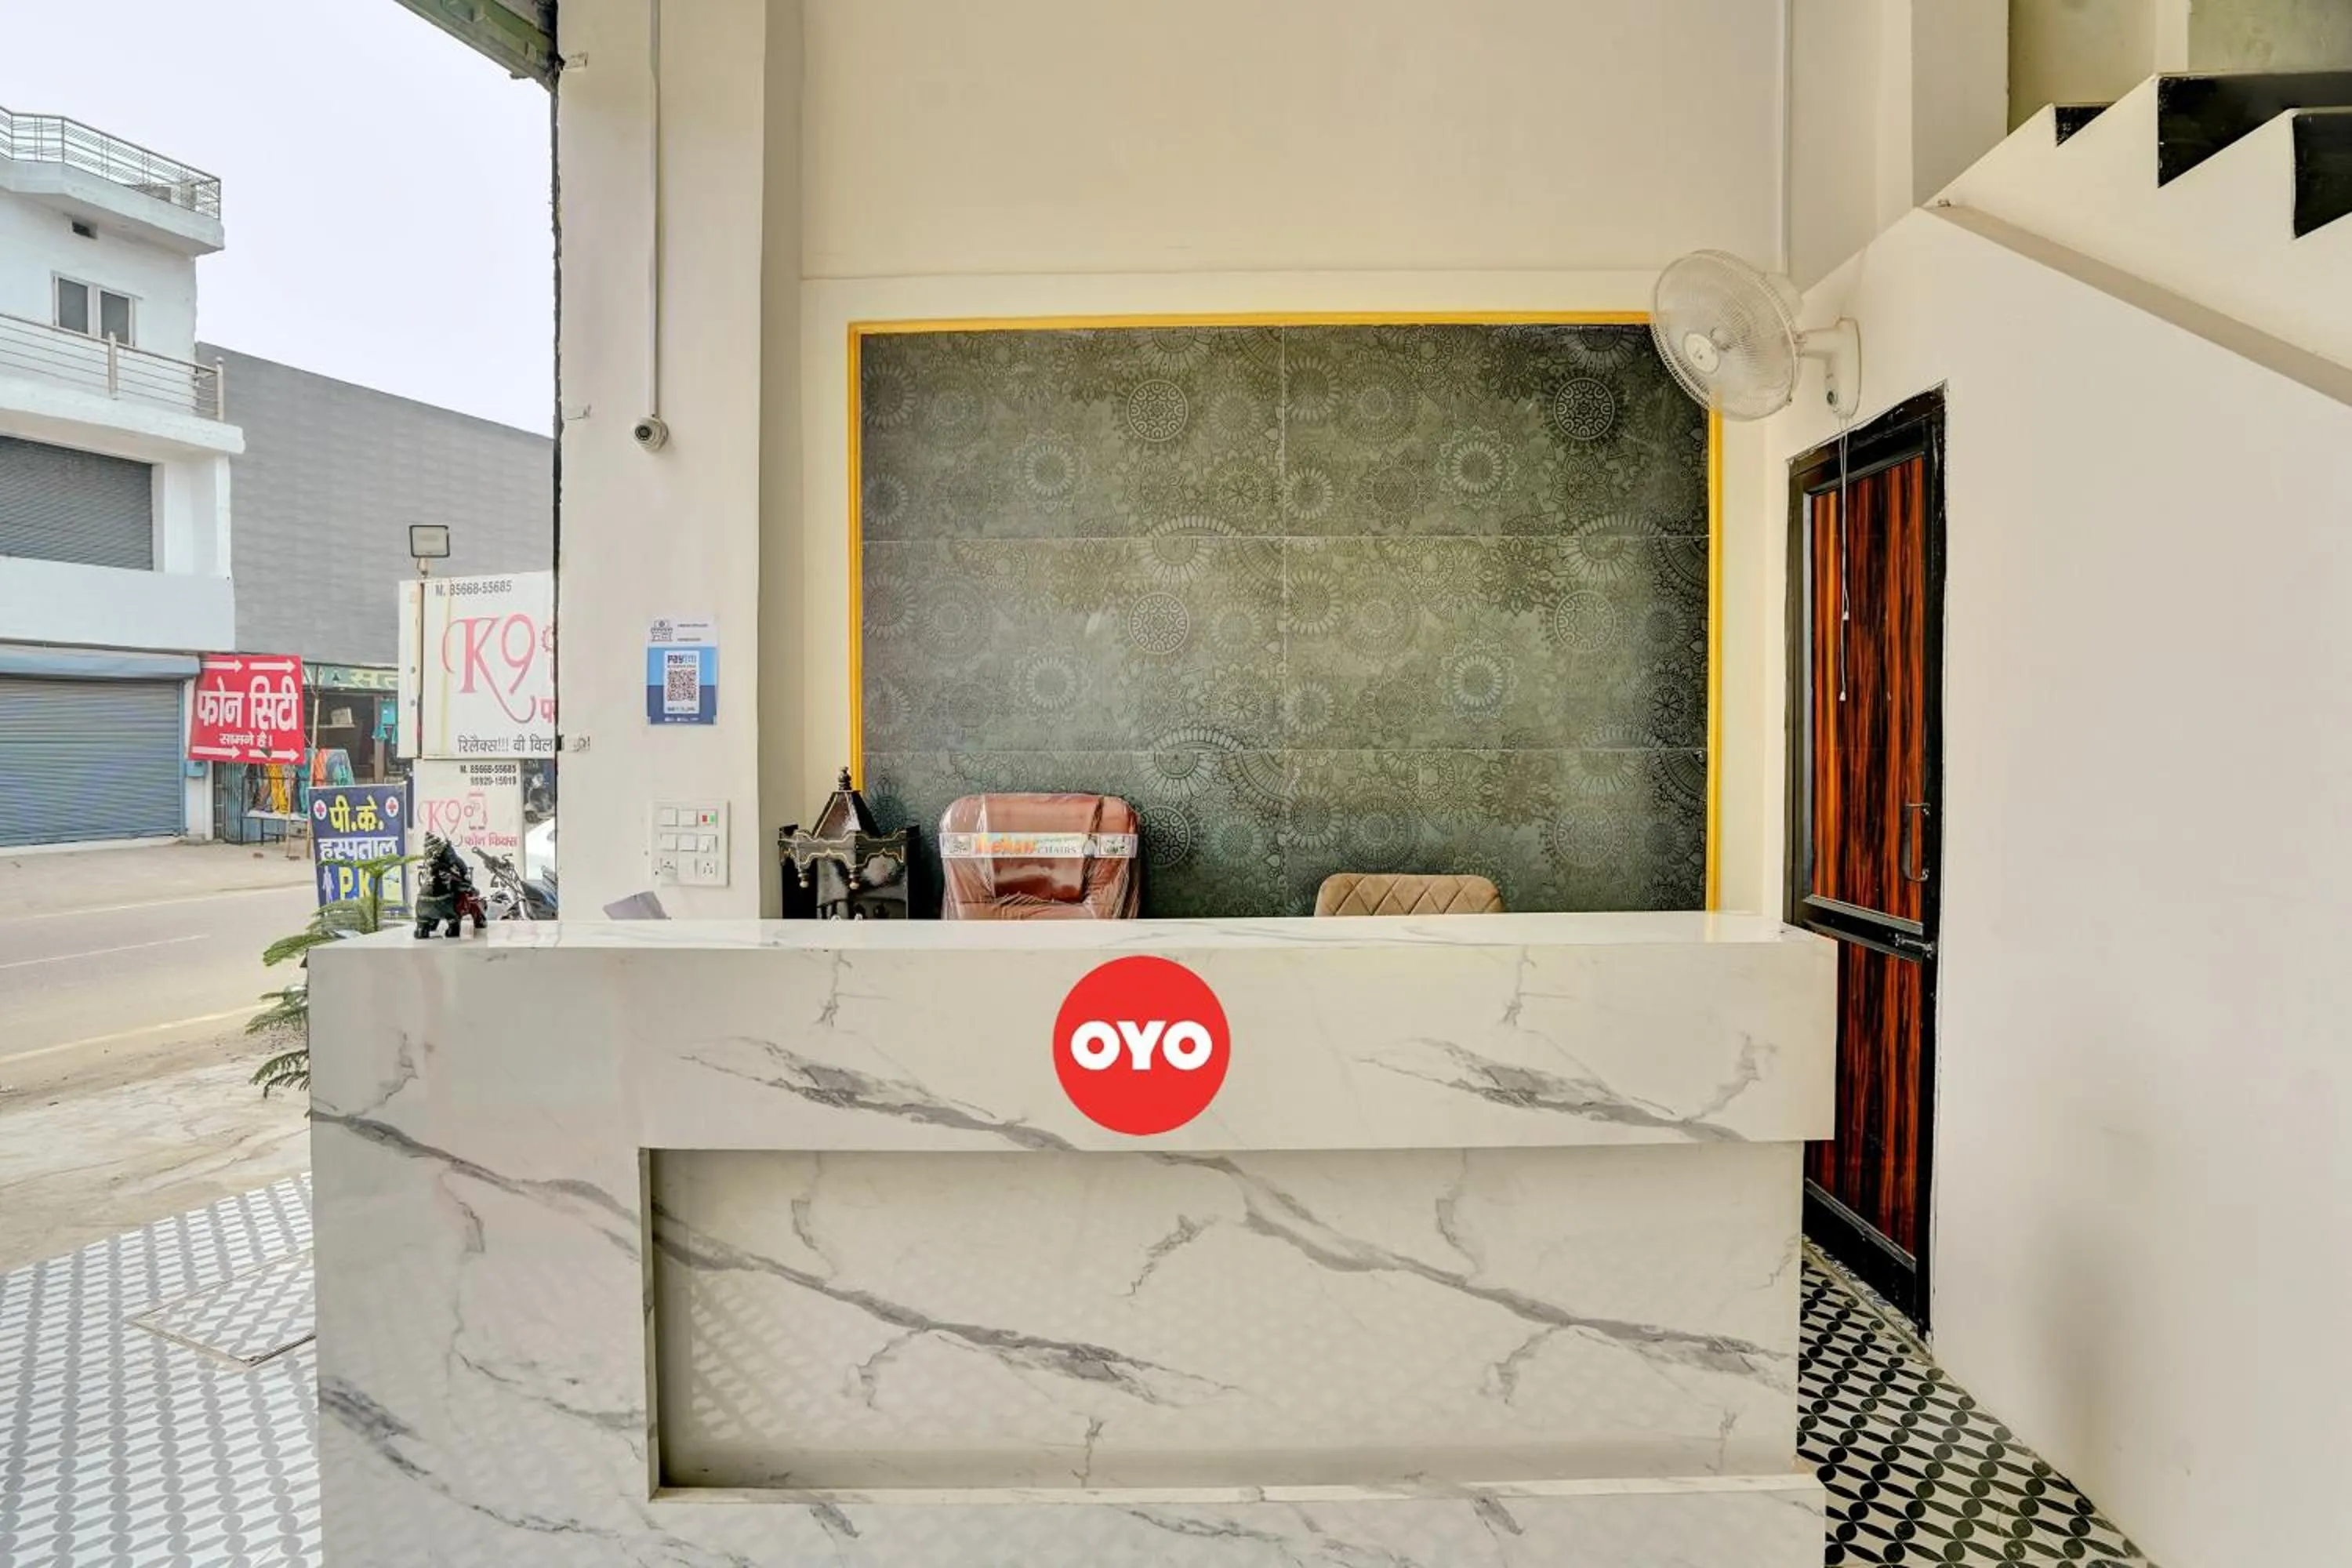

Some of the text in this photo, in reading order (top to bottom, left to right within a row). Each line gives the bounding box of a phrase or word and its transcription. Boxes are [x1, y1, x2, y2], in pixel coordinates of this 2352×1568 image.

[198, 675, 299, 731] फोन सिटी
[219, 730, 254, 746] सामने
[1070, 1020, 1213, 1071] OYO
